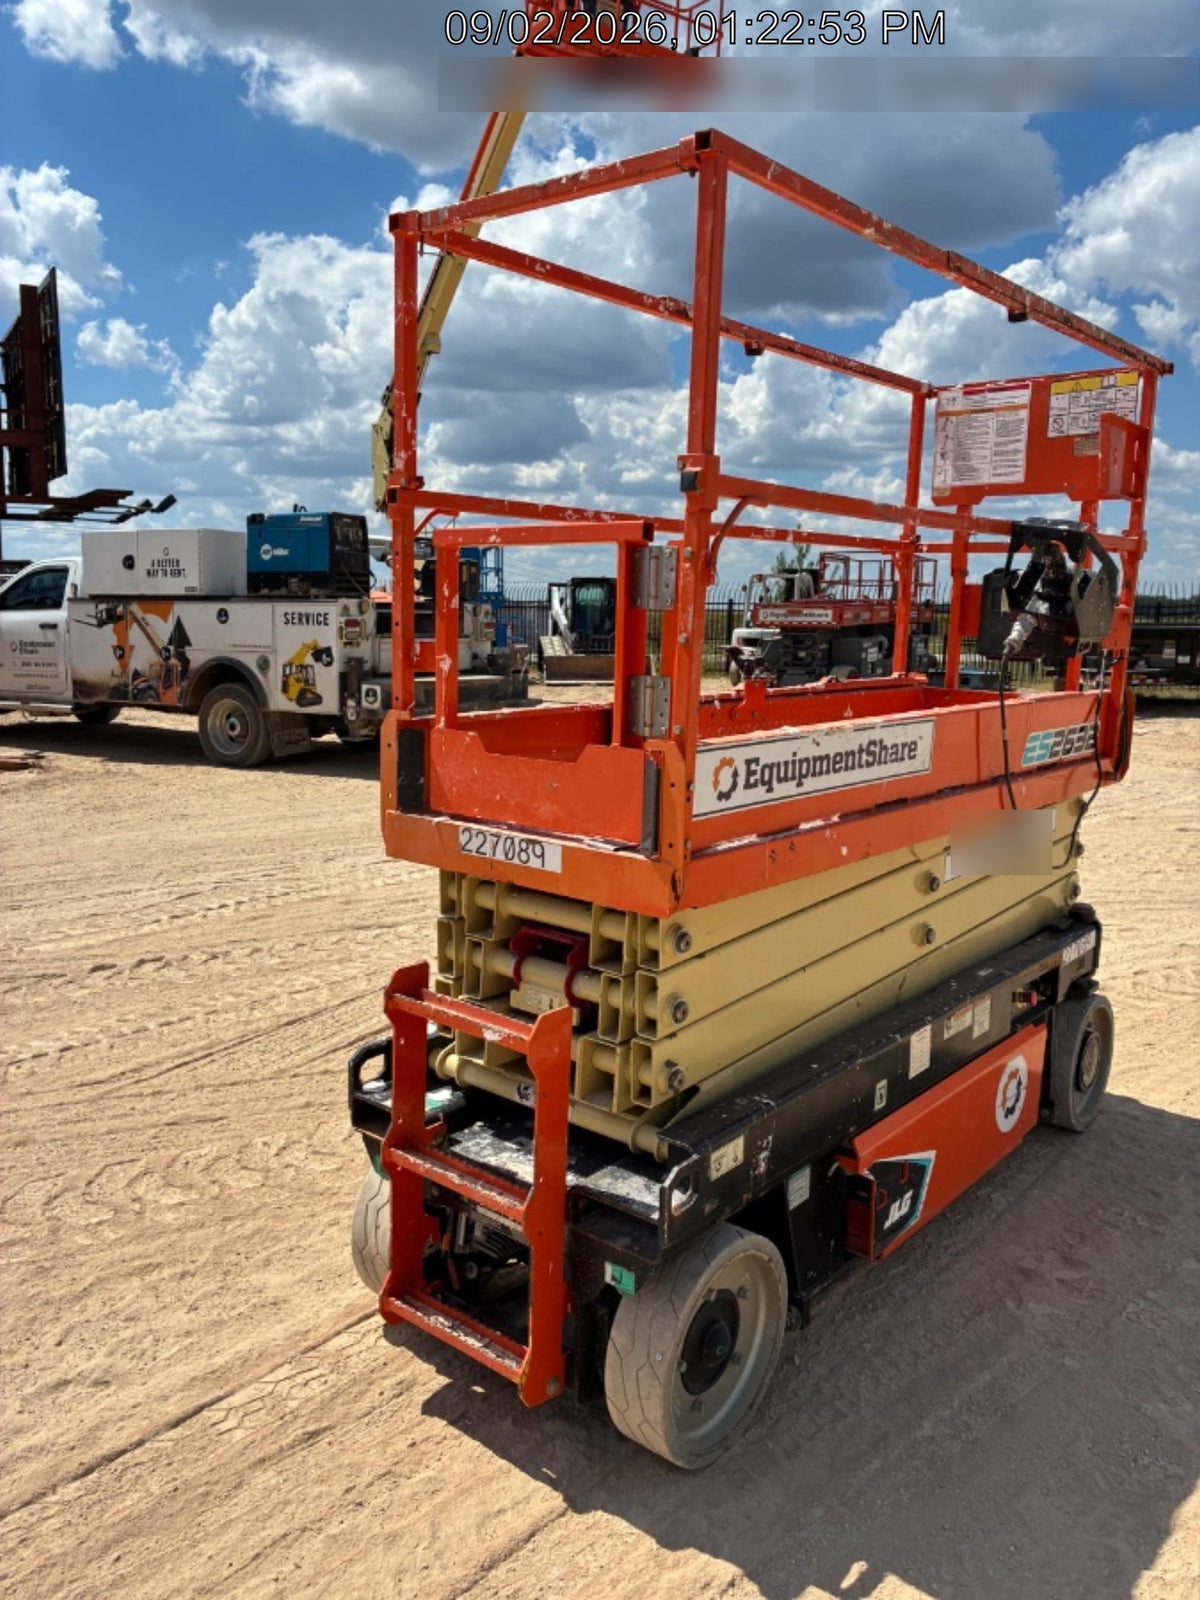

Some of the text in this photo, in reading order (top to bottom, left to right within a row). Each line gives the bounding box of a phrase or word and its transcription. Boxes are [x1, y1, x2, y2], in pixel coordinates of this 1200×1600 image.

[283, 611, 330, 626] SERVICE
[743, 739, 918, 793] EquipmentShare
[461, 826, 545, 868] 227089
[883, 1188, 914, 1230] JLG
